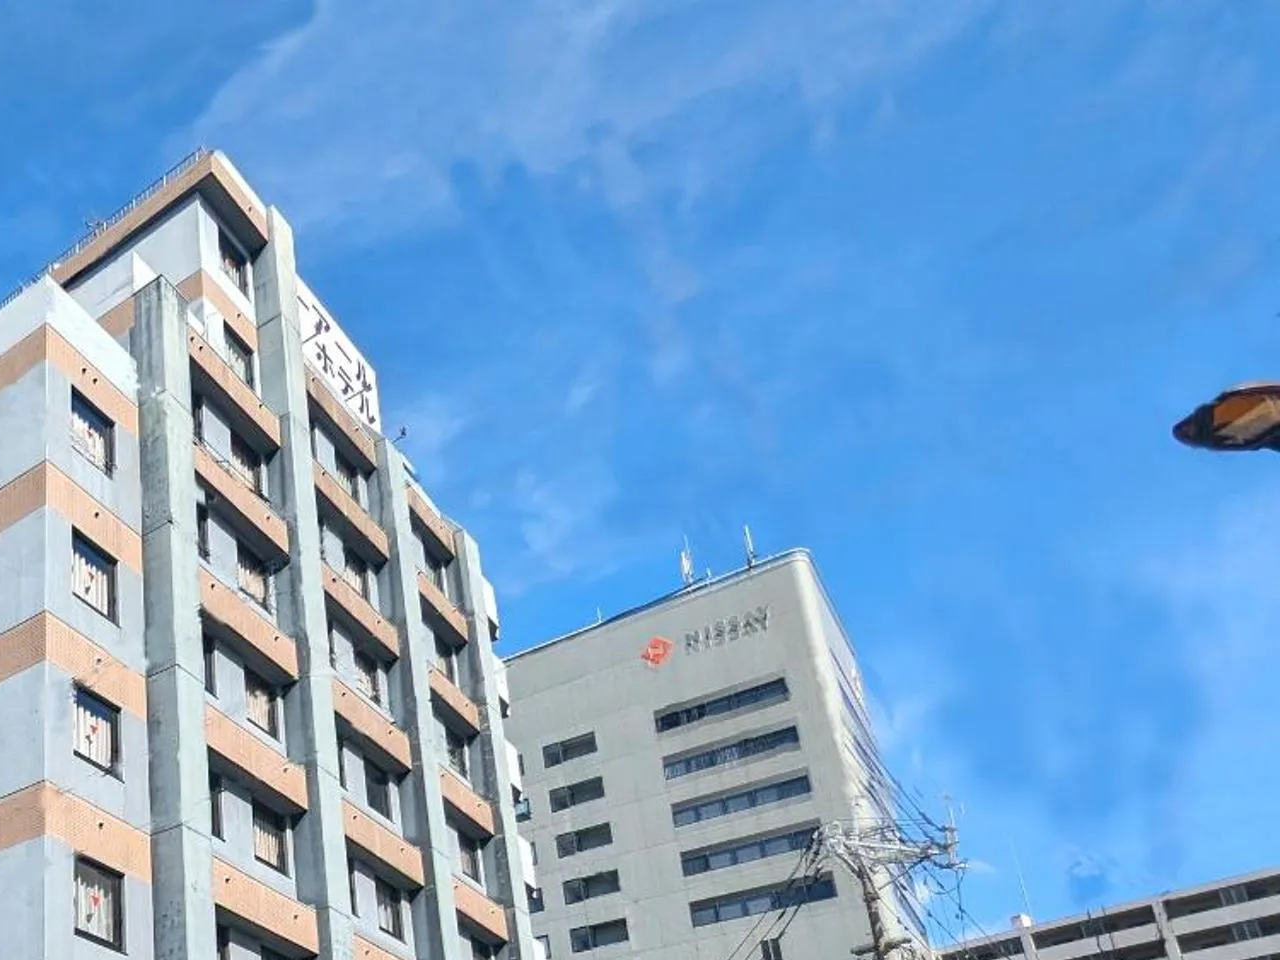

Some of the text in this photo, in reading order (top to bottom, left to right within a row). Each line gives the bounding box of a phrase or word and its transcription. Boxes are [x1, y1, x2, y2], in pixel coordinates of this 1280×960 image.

[315, 341, 376, 424] ホテル
[685, 604, 770, 655] NISSAY
